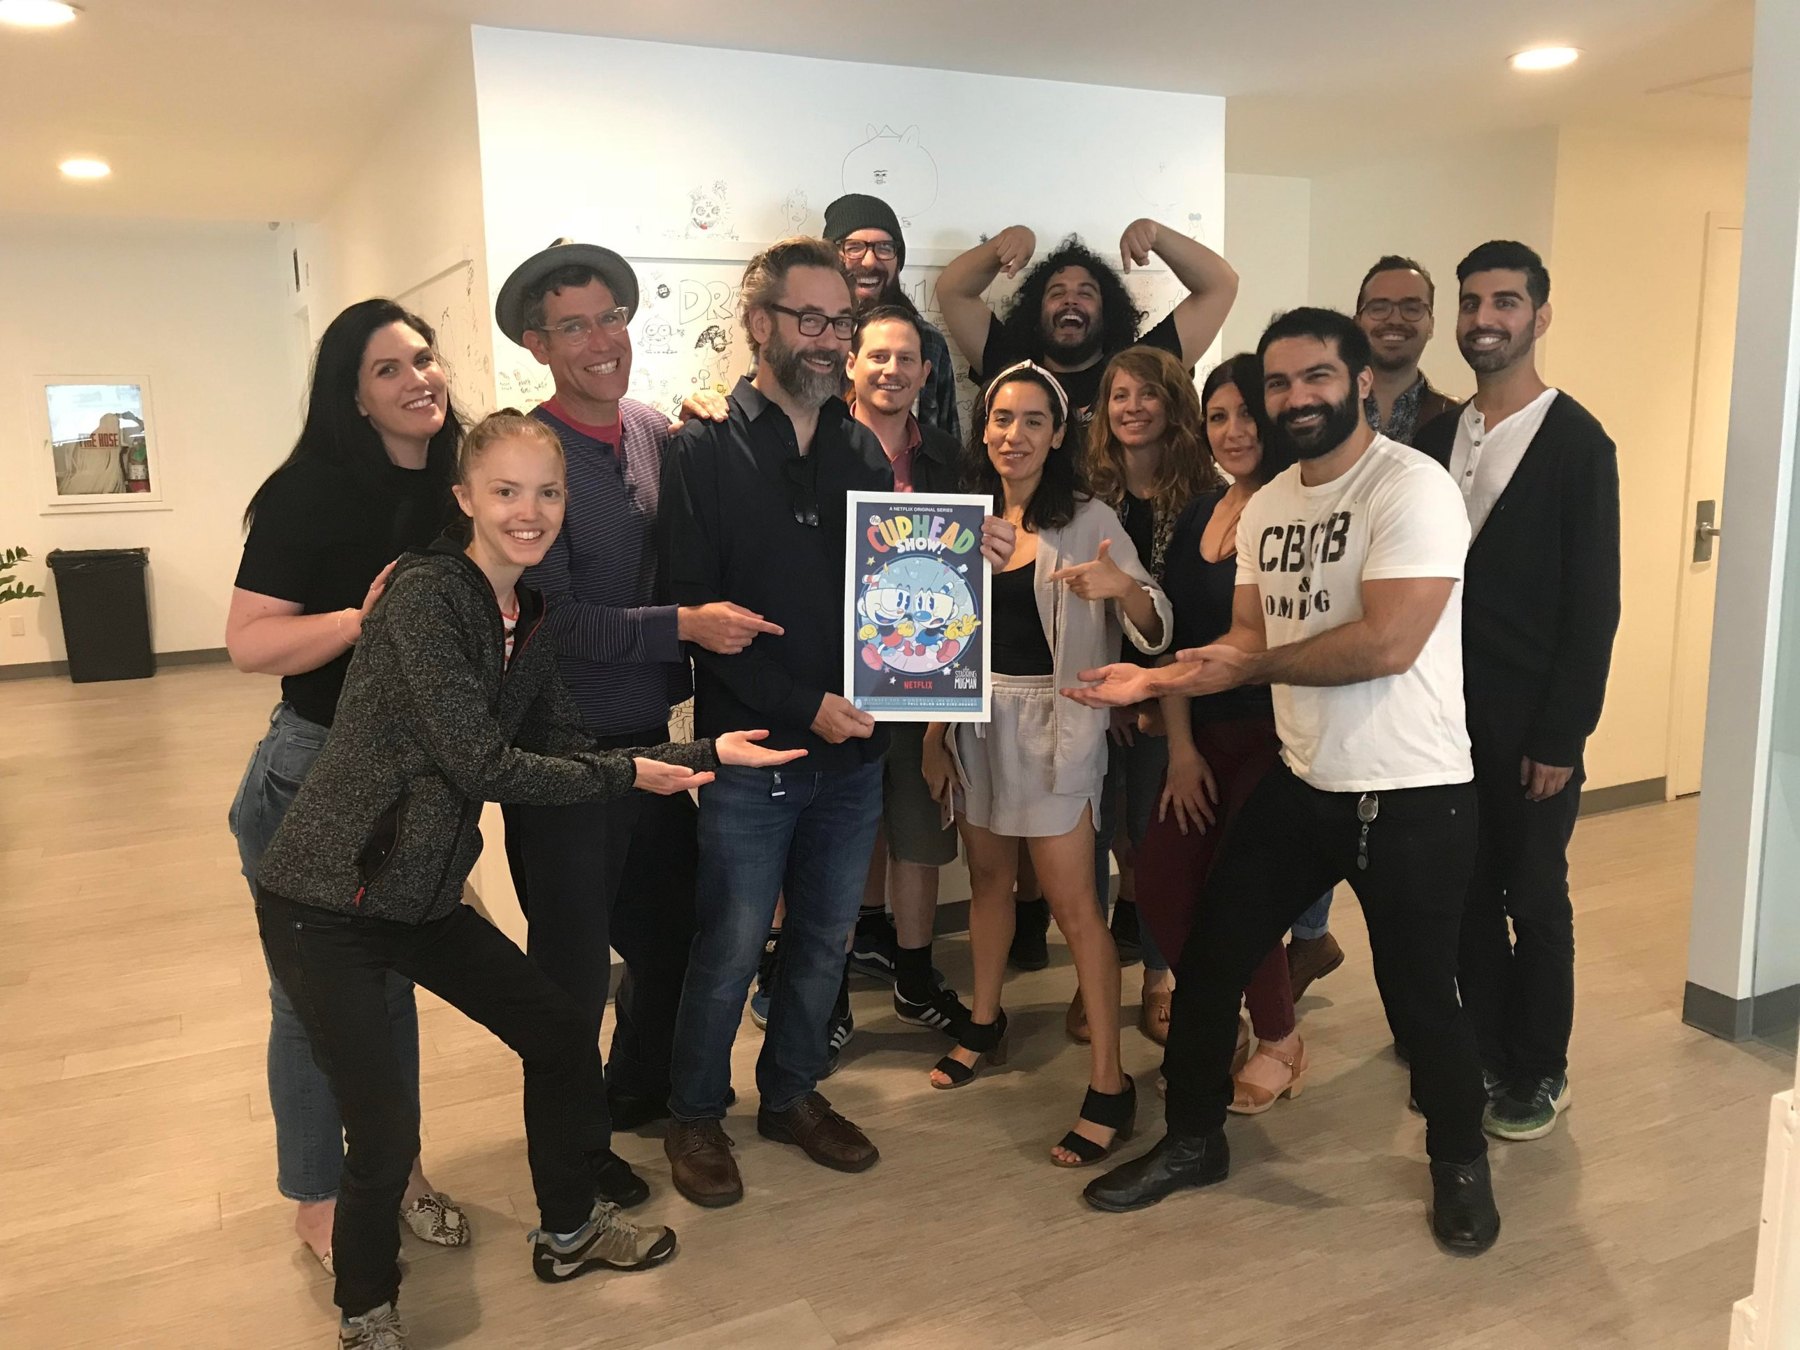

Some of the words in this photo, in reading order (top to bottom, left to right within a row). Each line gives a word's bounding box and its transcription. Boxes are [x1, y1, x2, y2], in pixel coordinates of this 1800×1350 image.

[98, 433, 118, 448] HOSE
[867, 514, 975, 554] CUPHEAD
[895, 537, 948, 555] SHOW!
[1298, 576, 1311, 593] &
[903, 680, 933, 690] NETFLIX
